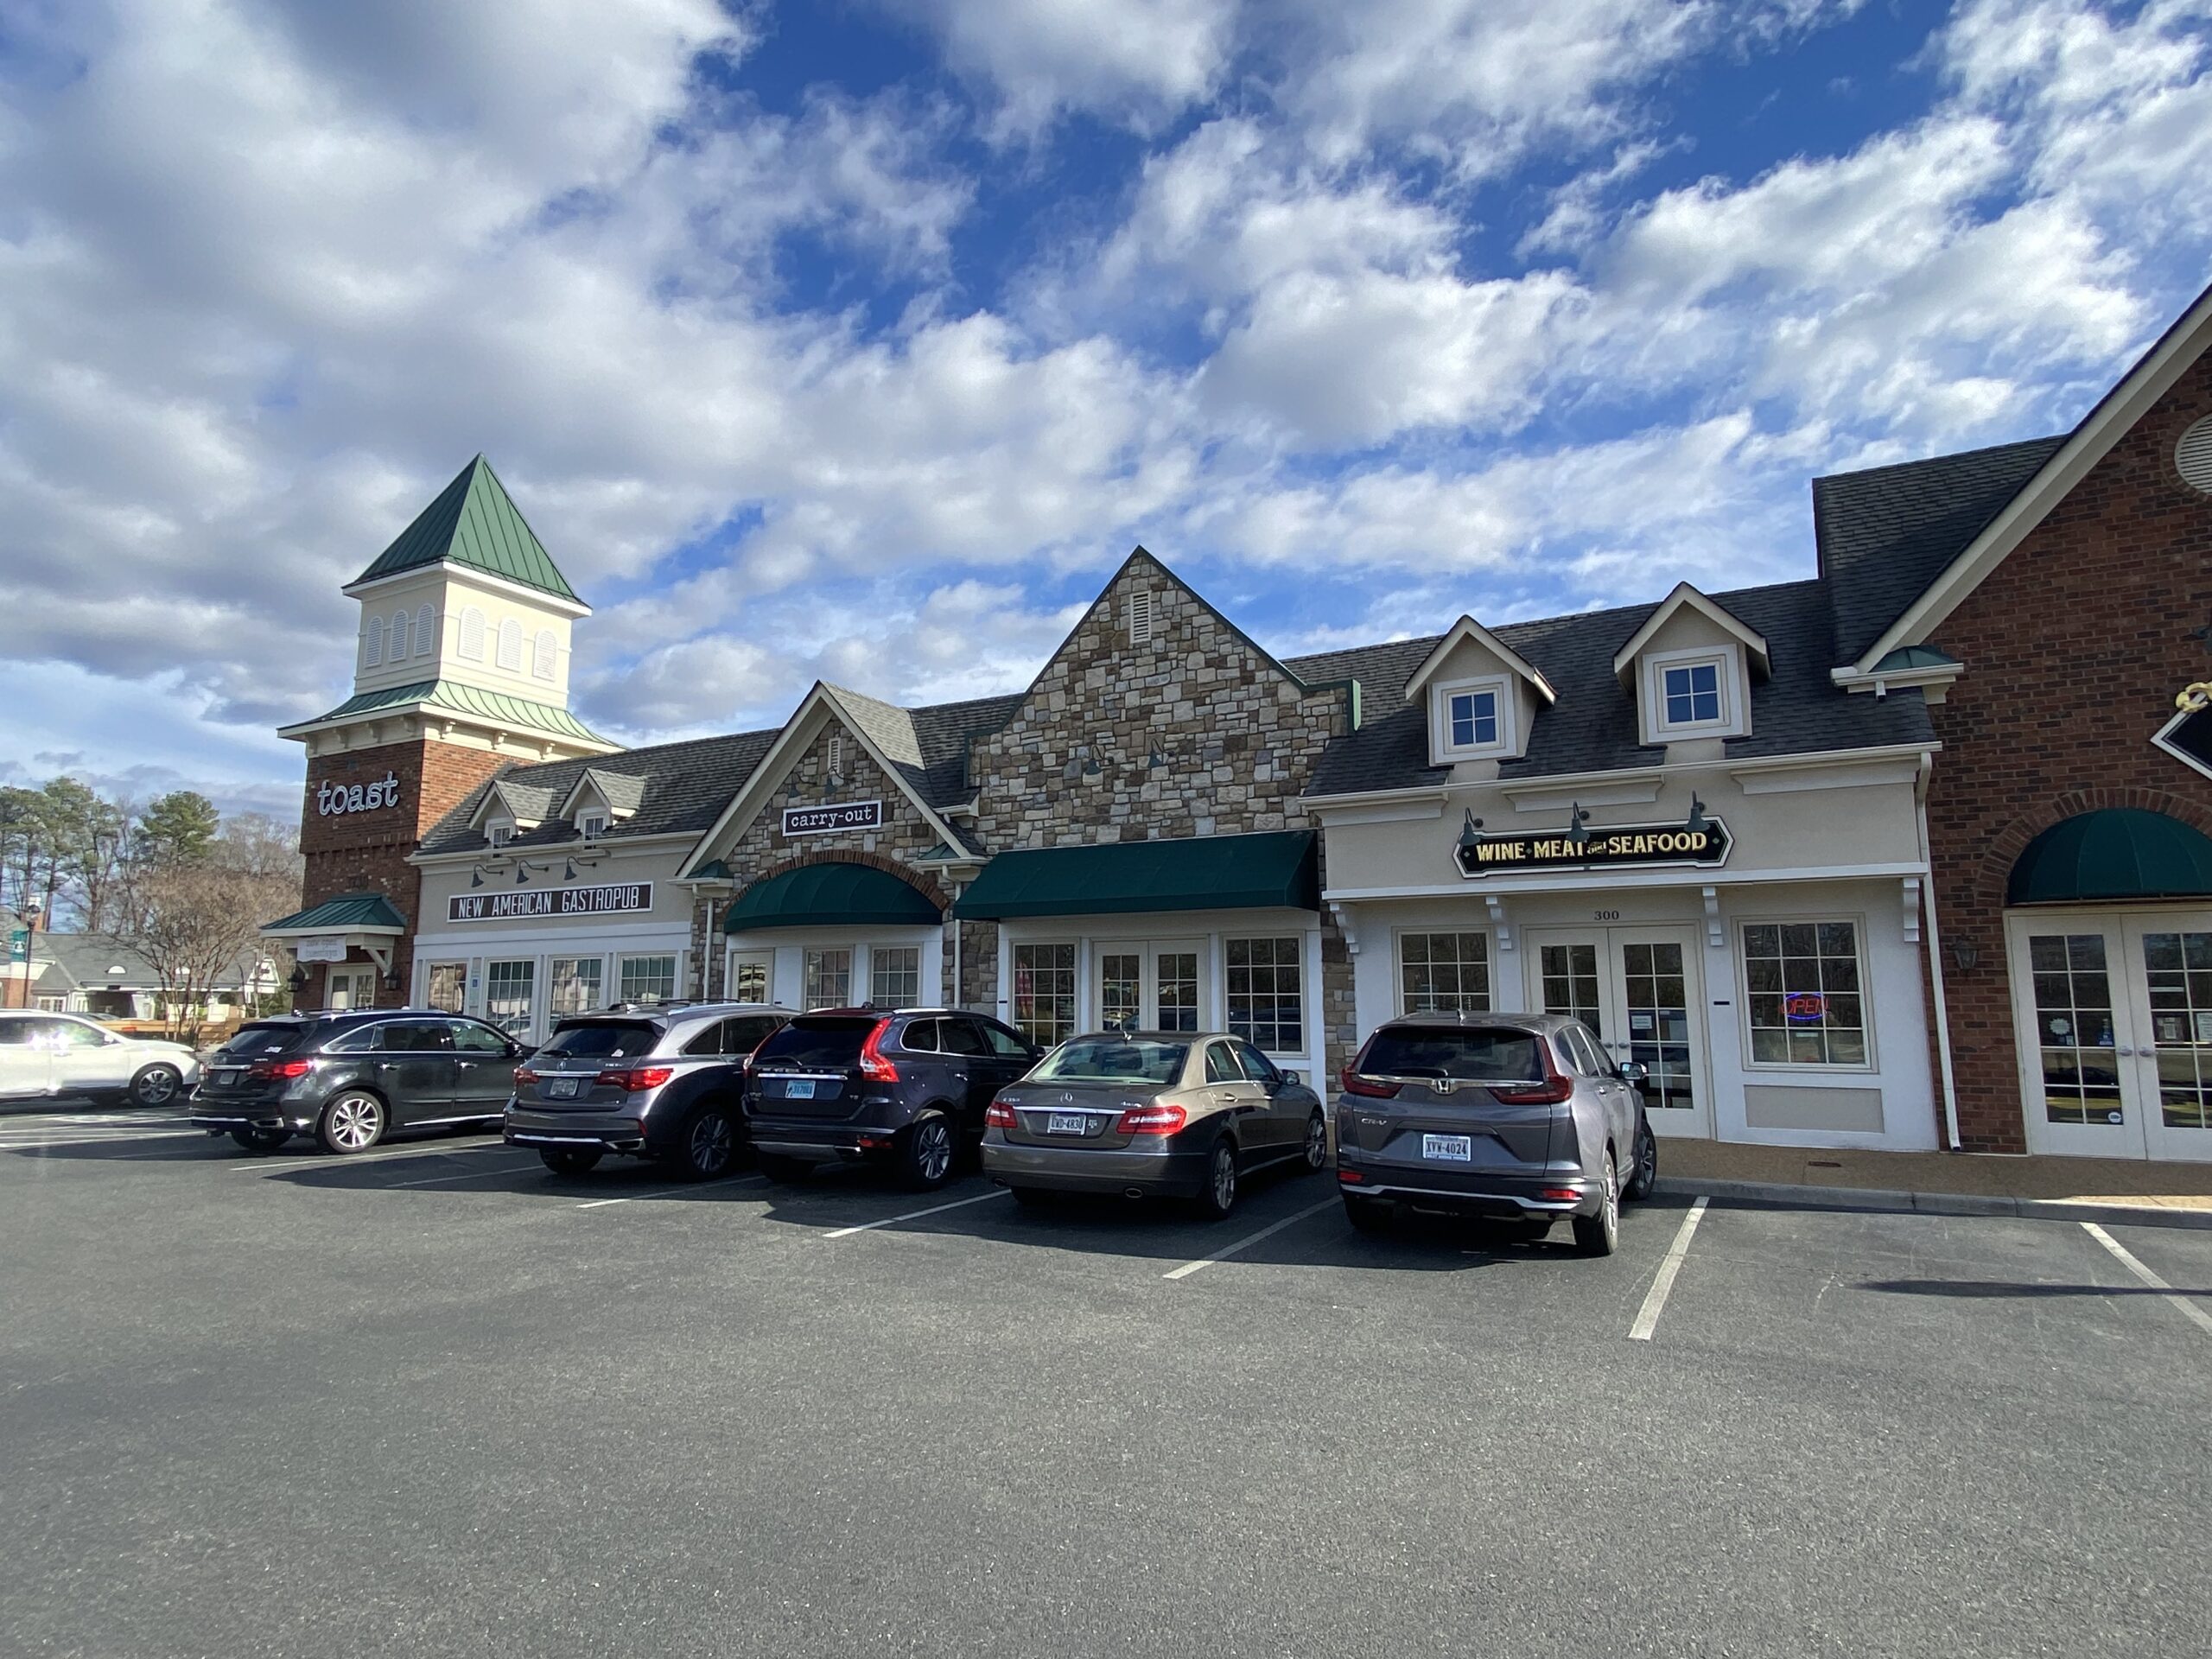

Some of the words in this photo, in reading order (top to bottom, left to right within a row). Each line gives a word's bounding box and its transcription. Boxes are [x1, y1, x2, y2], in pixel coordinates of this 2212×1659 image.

[317, 771, 398, 816] toast
[791, 805, 873, 828] carry-out
[1476, 842, 1526, 861] WINE
[1534, 839, 1584, 859] MEAT
[1609, 832, 1707, 855] SEAFOOD
[458, 898, 484, 918] NEW
[492, 893, 551, 916] AMERICAN
[562, 887, 639, 912] GASTROPUB
[1594, 910, 1619, 920] 300
[1778, 996, 1829, 1014] OPEN
